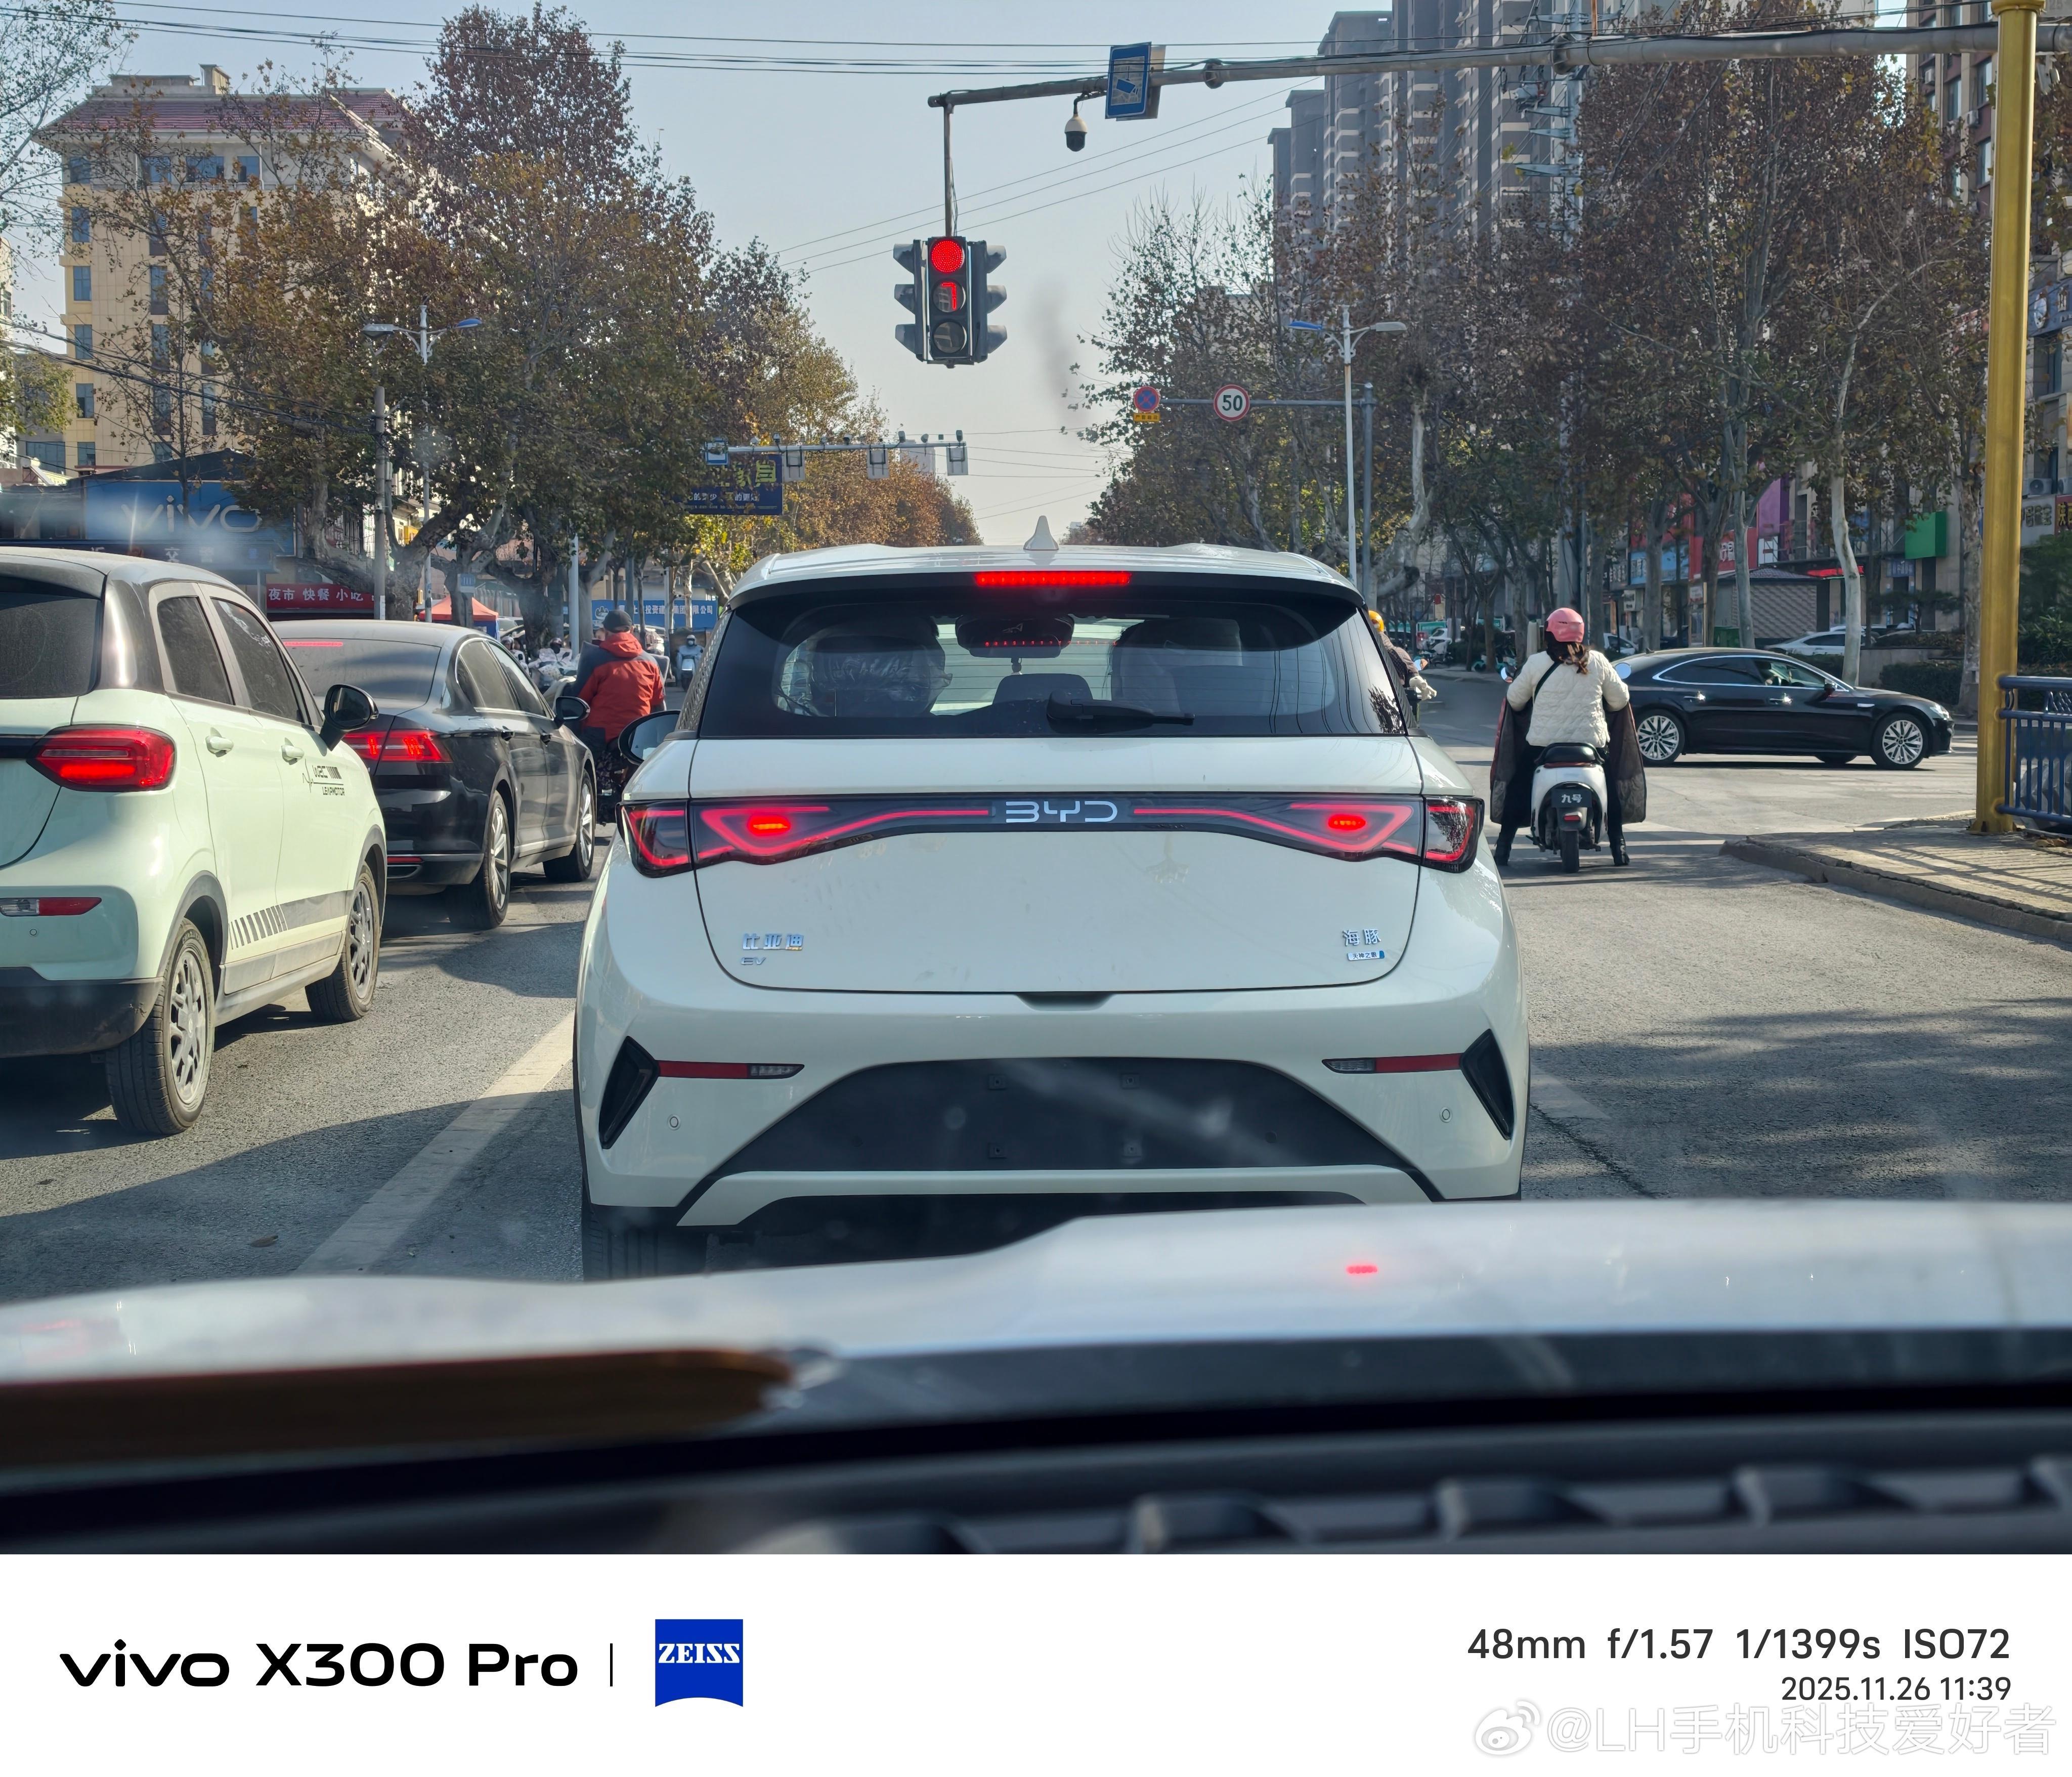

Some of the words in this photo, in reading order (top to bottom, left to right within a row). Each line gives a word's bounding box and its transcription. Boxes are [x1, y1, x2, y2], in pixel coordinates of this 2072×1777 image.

[1222, 395, 1243, 411] 50
[121, 495, 263, 533] vivo
[269, 587, 295, 601] 夜市
[303, 588, 330, 601] 快餐
[336, 588, 364, 601] 小吃
[322, 786, 345, 796] LEAPMOTOR
[1561, 794, 1582, 803] 九号
[1006, 800, 1118, 823] BYD
[743, 934, 804, 951] 比亚迪
[1342, 929, 1382, 946] 海豚
[741, 957, 767, 965] EV
